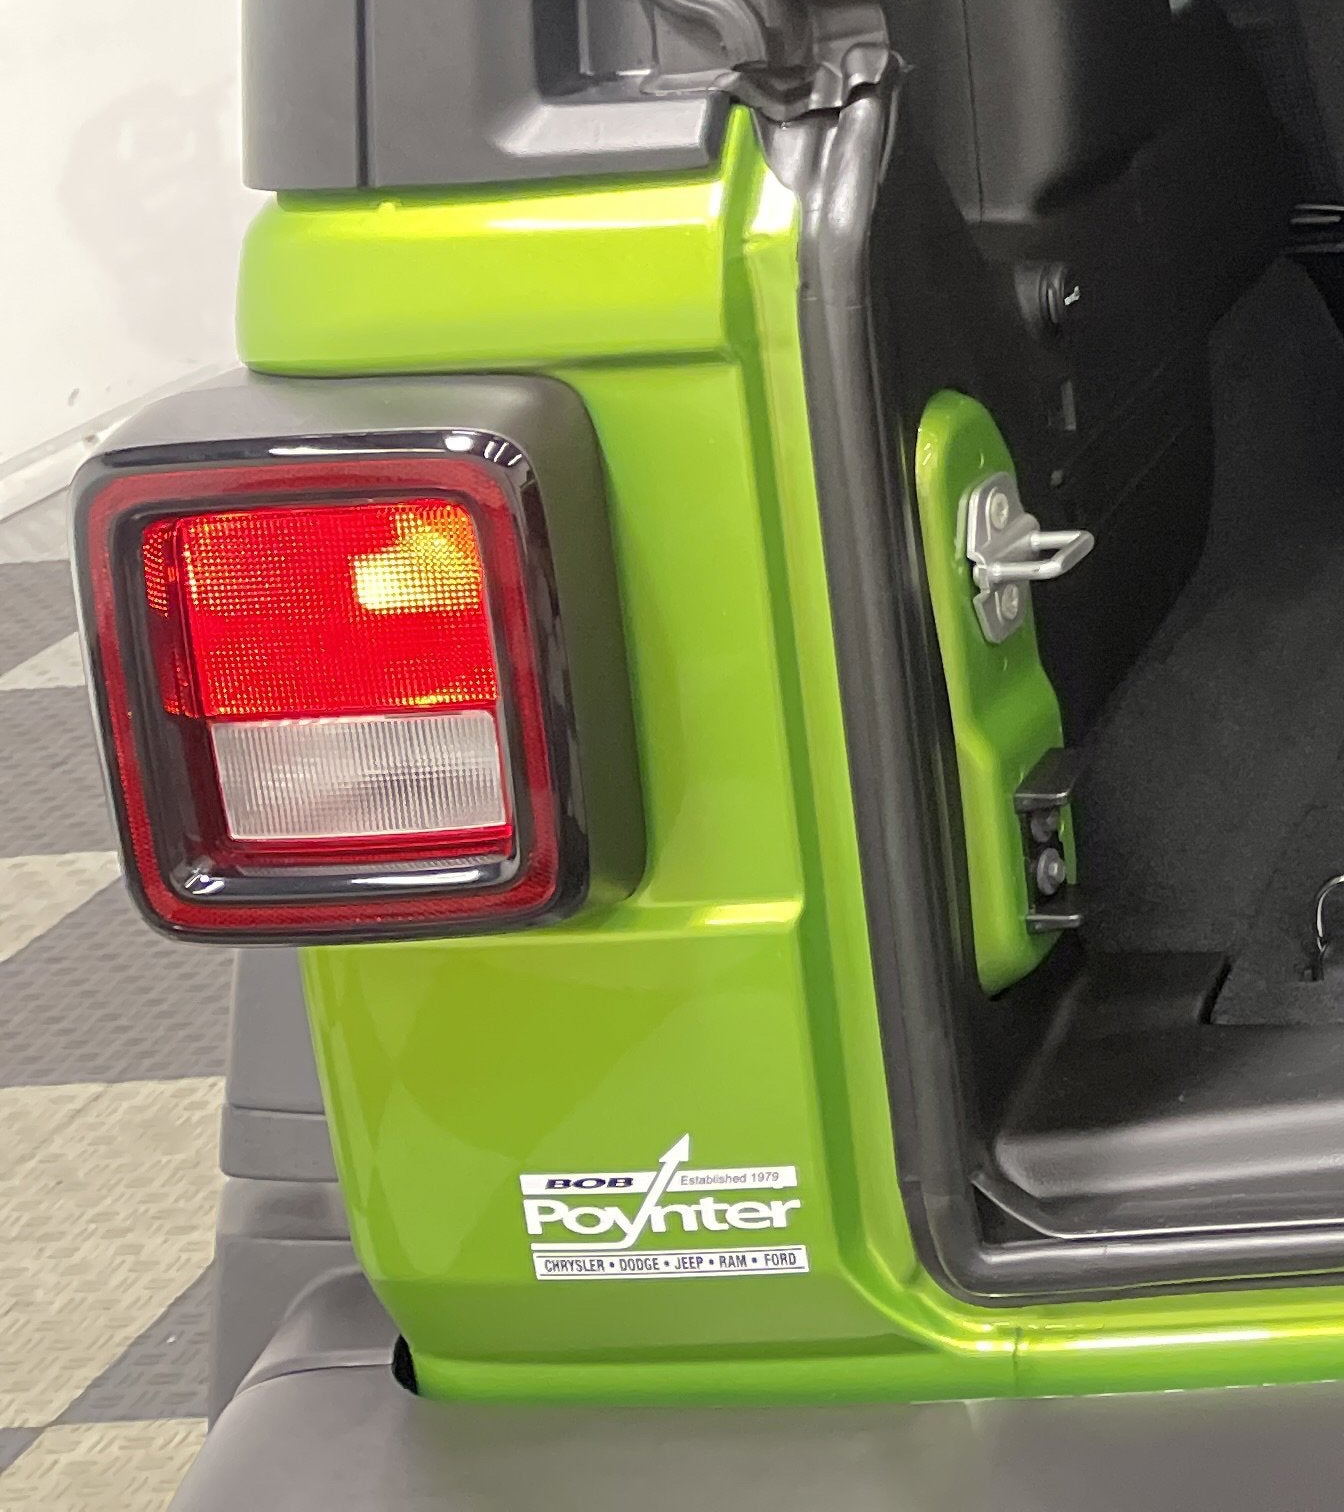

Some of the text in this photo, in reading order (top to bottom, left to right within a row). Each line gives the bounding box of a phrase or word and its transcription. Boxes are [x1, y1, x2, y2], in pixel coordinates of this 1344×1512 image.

[545, 1177, 633, 1189] BOB
[681, 1172, 779, 1185] Established 1979
[523, 1197, 801, 1249] Poynter
[544, 1254, 796, 1272] CHRYSLER DODGE JEEP RAM FORD
